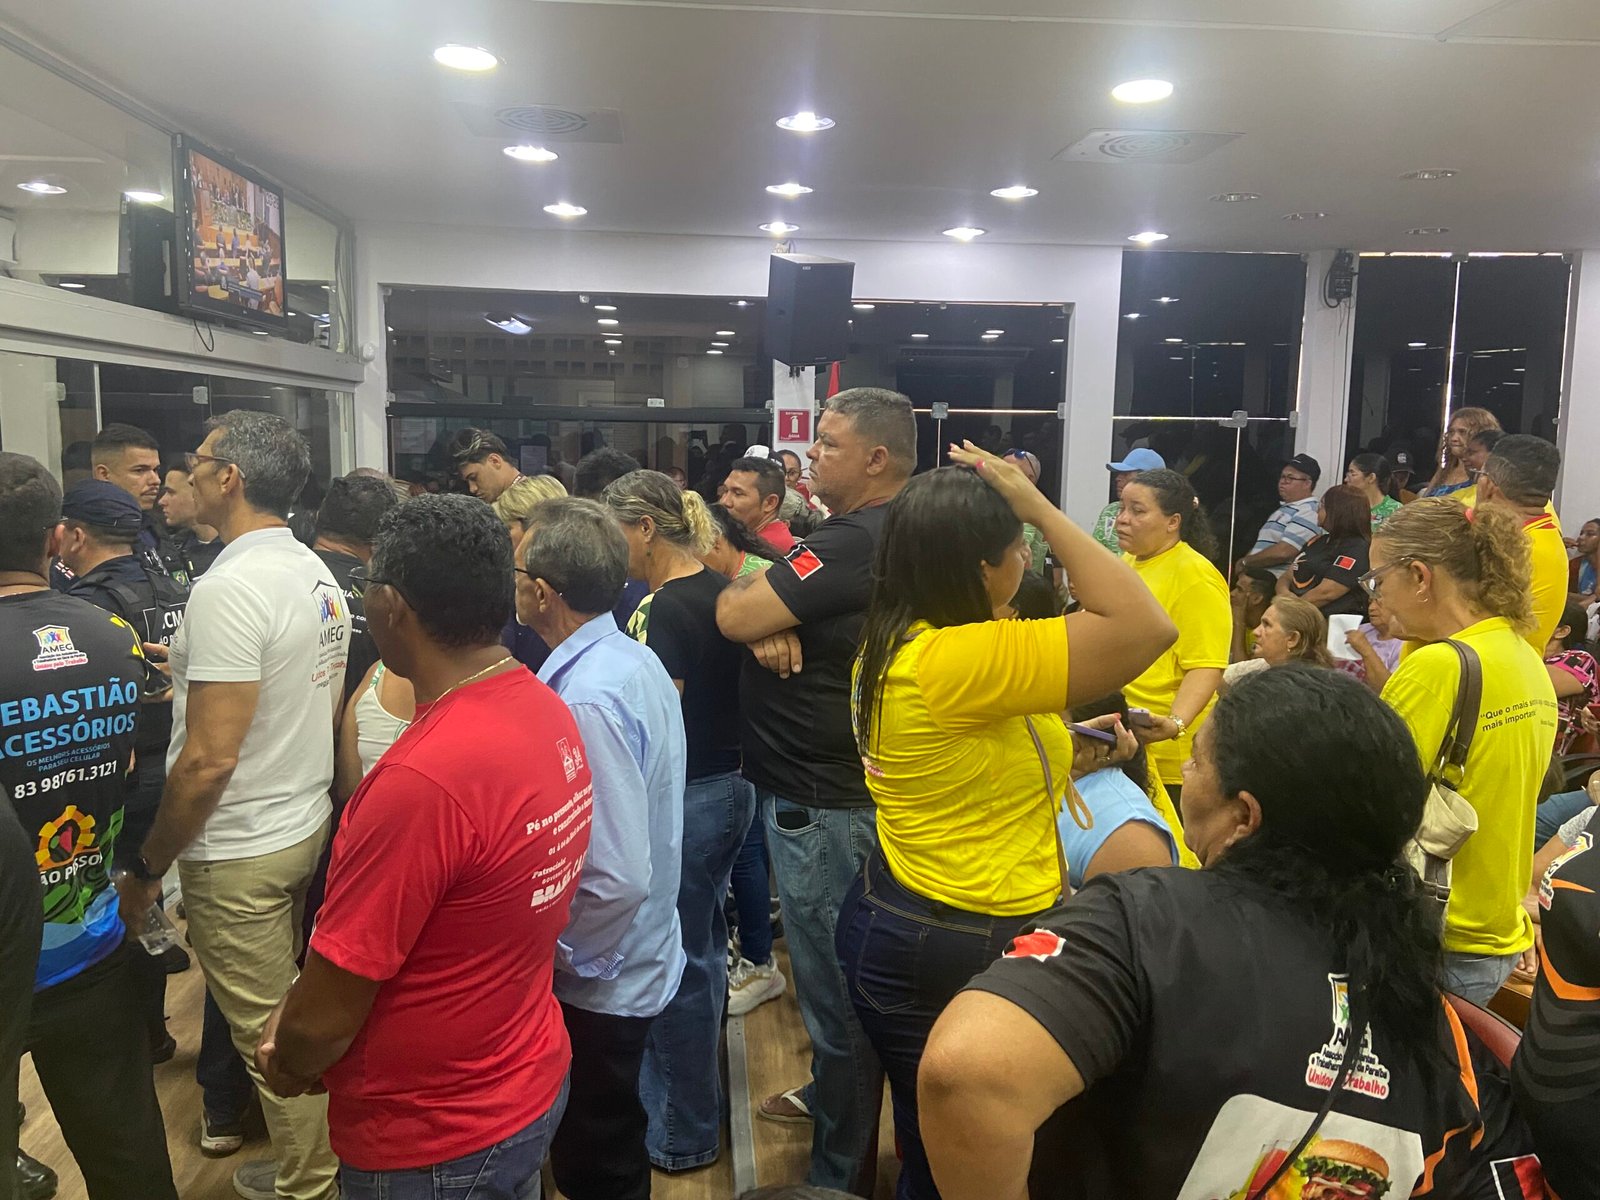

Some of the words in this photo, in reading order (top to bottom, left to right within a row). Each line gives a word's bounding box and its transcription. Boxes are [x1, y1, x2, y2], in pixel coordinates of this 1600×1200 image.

[162, 609, 184, 629] CM
[319, 624, 344, 648] AMEG
[42, 643, 73, 654] AMEG
[0, 676, 138, 727] EBASTIÃO
[1512, 700, 1529, 711] mais
[0, 711, 136, 760] CESSÓRIOS
[1482, 719, 1503, 732] mais
[26, 759, 38, 767] OS
[38, 763, 57, 772] PARA
[69, 752, 101, 763] CELULAR
[14, 781, 37, 799] 83
[41, 760, 118, 793] 98761.3121
[526, 818, 541, 835] Pé
[541, 815, 553, 828] no
[40, 870, 61, 886] ÃO
[1308, 1068, 1334, 1088] Unidos
